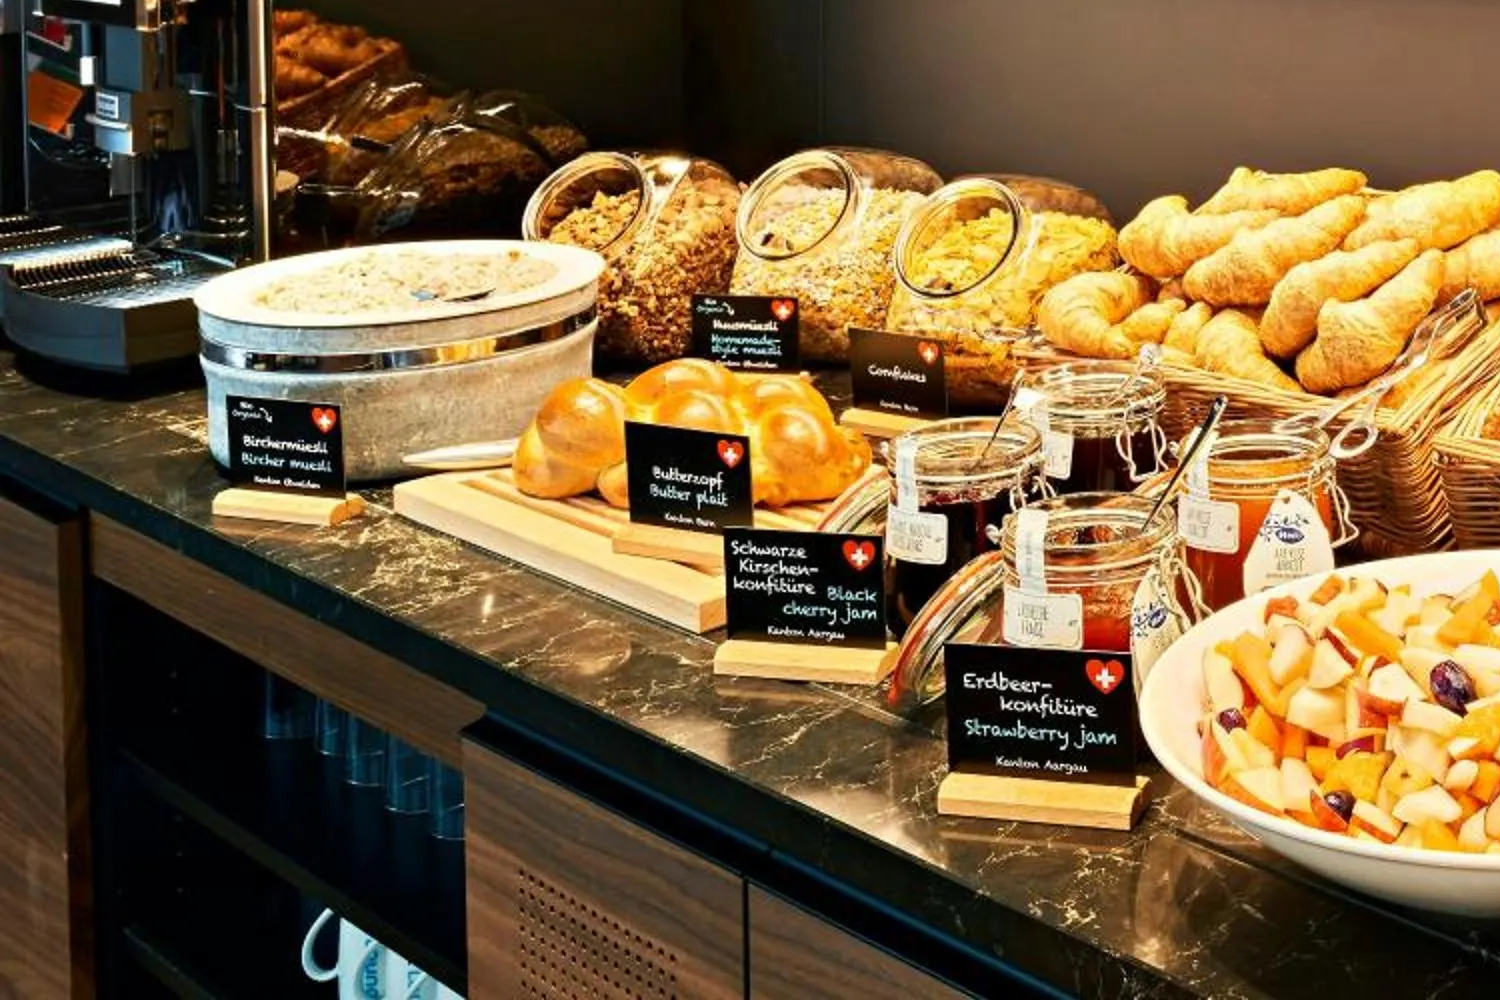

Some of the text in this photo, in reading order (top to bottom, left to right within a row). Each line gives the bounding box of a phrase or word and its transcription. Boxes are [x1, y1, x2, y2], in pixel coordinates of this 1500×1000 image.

[242, 435, 329, 455] Birchermüesli
[241, 452, 333, 474] Bircher muesli
[651, 465, 725, 495] Butterzopf
[649, 483, 729, 512] Butter plait
[730, 539, 808, 560] Schwarze
[738, 559, 819, 578] Kirschen-
[732, 575, 877, 603] konfitüre Black
[782, 601, 877, 626] cherry jam
[767, 625, 846, 644] Kanton Aargau
[963, 671, 1053, 694] Erdbeer-
[999, 694, 1099, 719] konfitüre
[964, 717, 1118, 751] Strawberry jam
[995, 755, 1089, 775] Kanton Aargau
